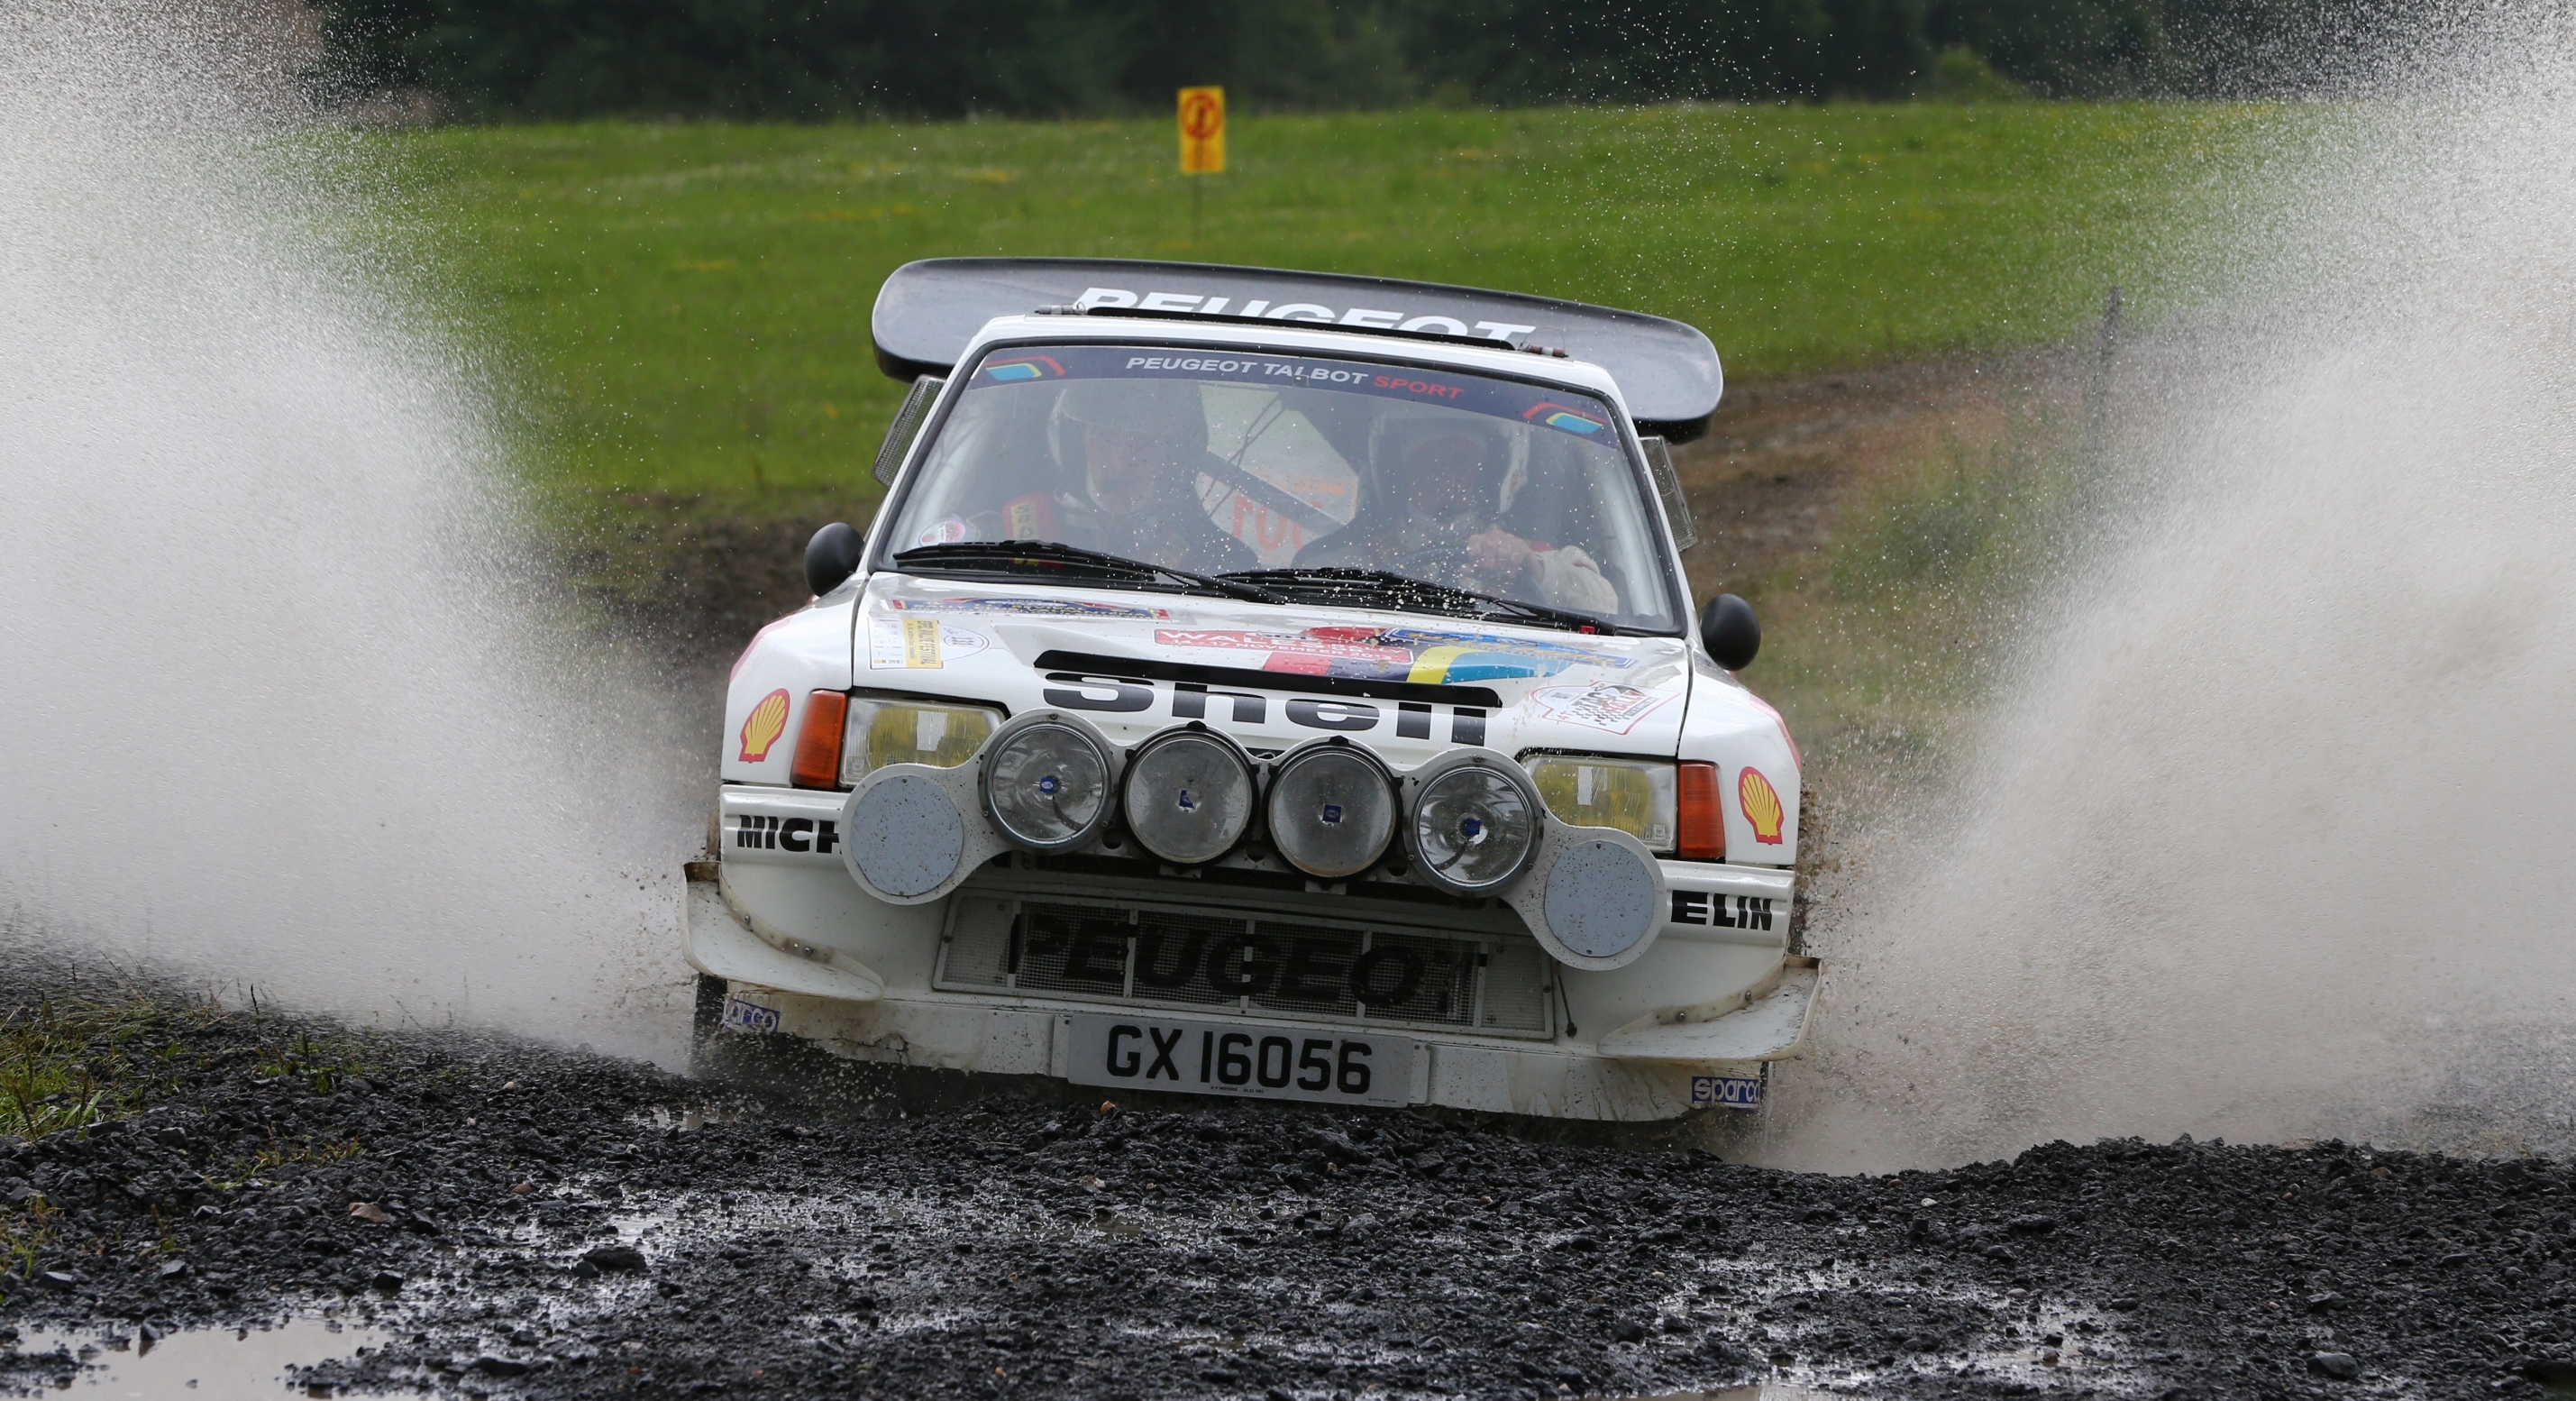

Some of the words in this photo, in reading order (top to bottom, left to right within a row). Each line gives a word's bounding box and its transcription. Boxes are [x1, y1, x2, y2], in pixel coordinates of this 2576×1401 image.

[1126, 357, 1256, 373] PEUGEOT
[1264, 362, 1368, 385] TALBOT
[1374, 375, 1465, 398] SPORT
[1157, 630, 1325, 649] WALES
[1043, 672, 1487, 746] Shell
[1671, 889, 1773, 931] ELIN
[1106, 1024, 1183, 1081] GX
[1200, 1030, 1373, 1094] 16056
